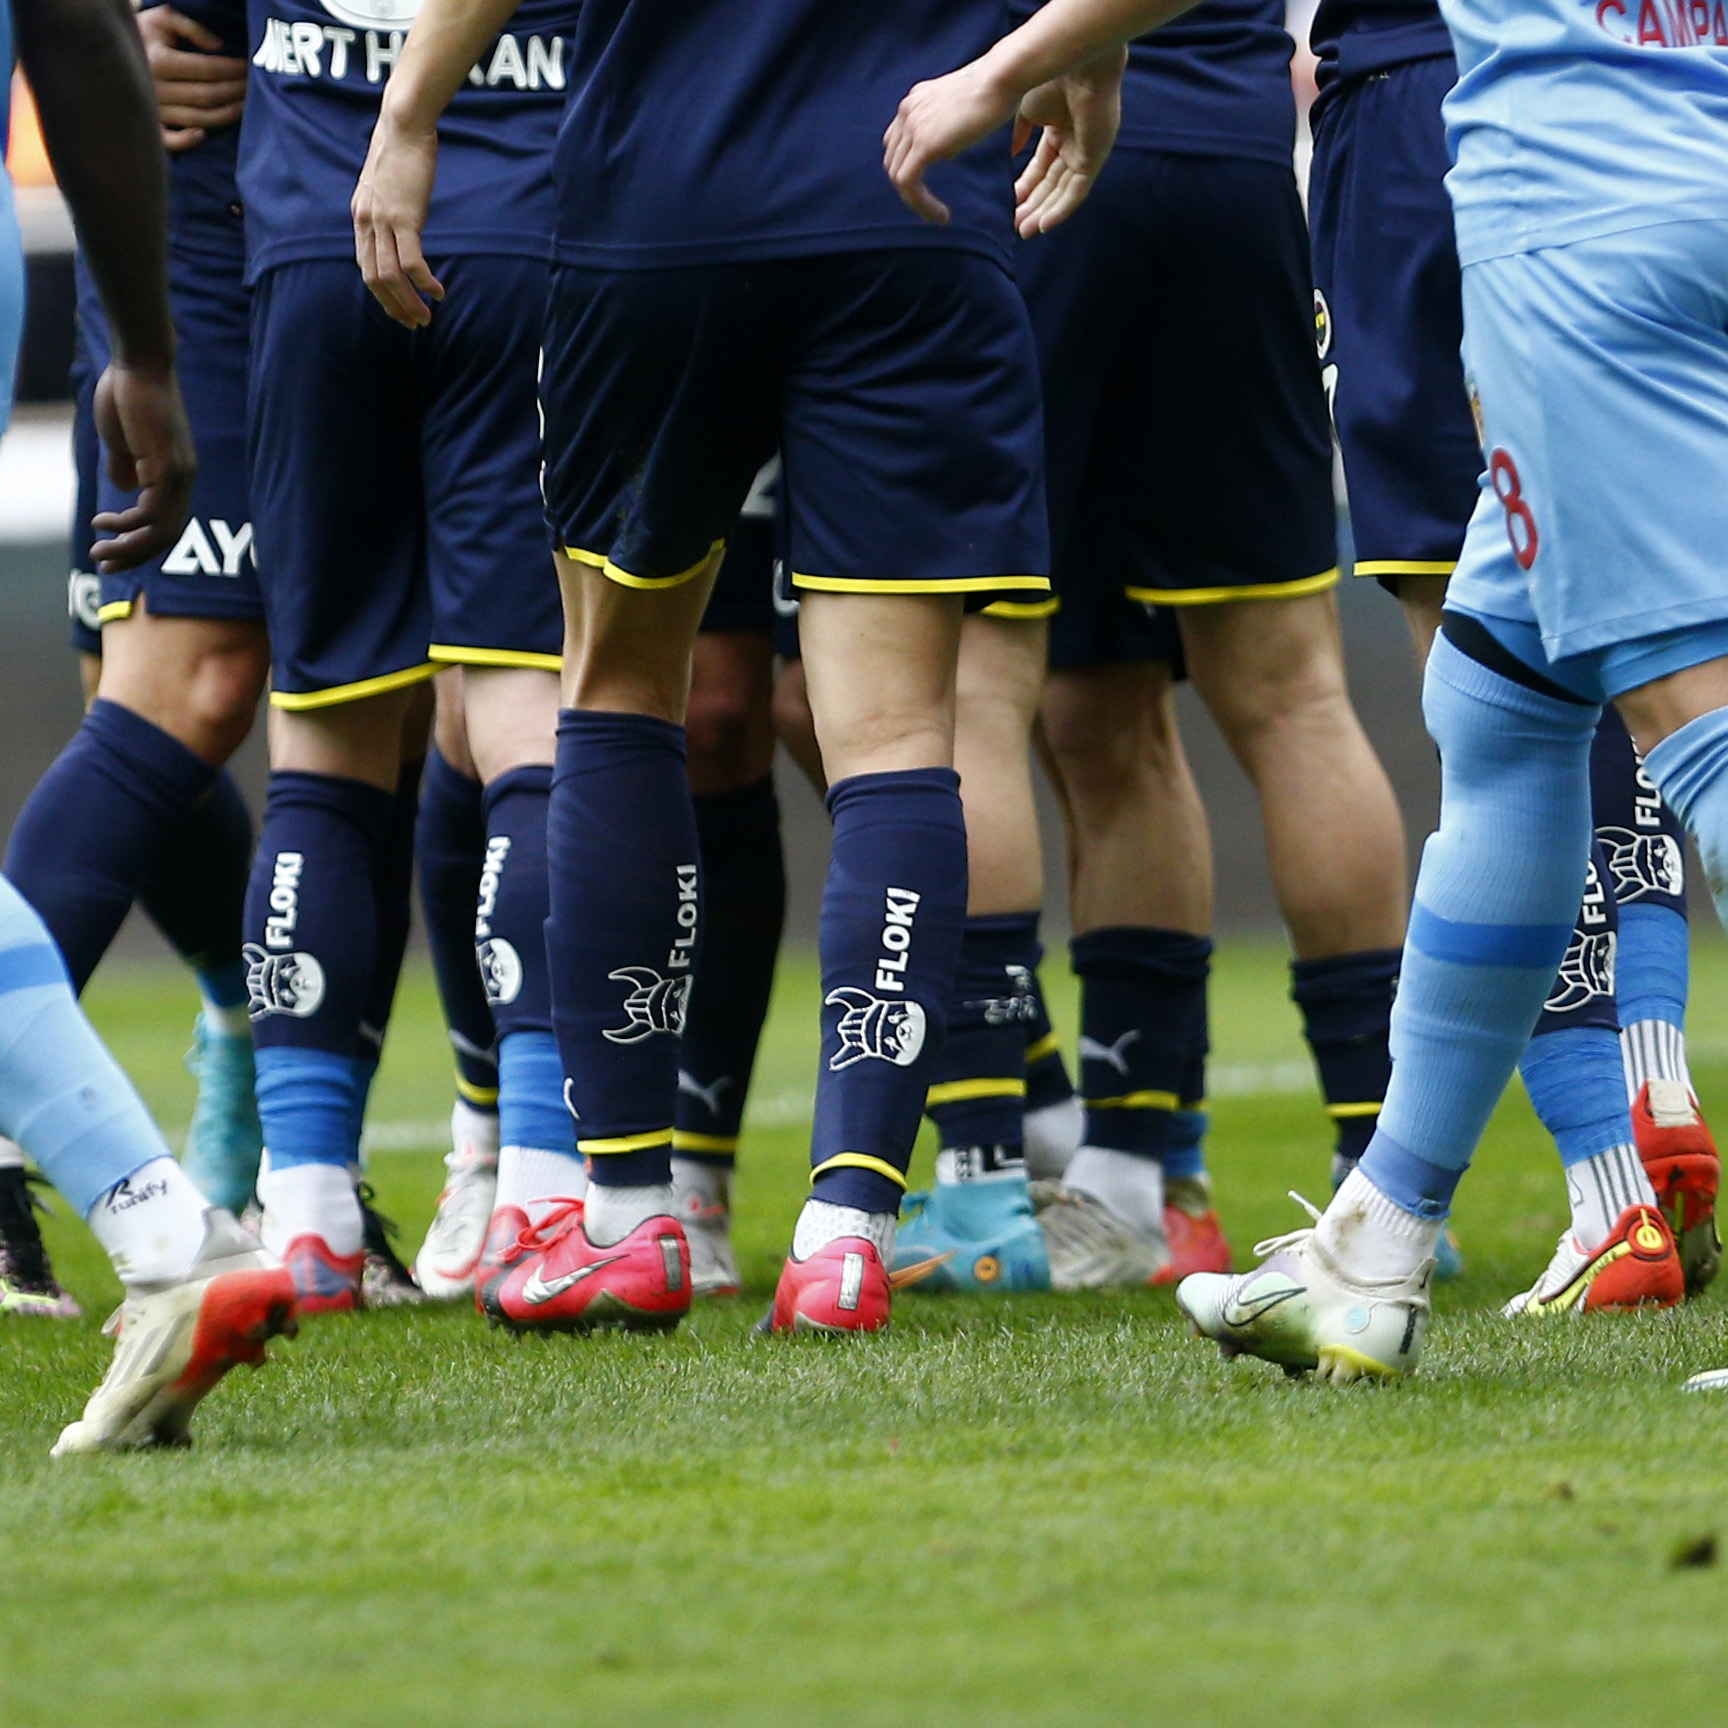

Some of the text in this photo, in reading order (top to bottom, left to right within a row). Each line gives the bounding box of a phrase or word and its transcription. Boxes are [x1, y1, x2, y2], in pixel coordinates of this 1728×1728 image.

[364, 29, 567, 92] HAN
[160, 515, 259, 578] AY
[262, 850, 306, 949] FLOKI
[475, 834, 512, 940] FLOKI
[666, 863, 699, 970] FLOKI
[874, 886, 922, 993] FLOKI
